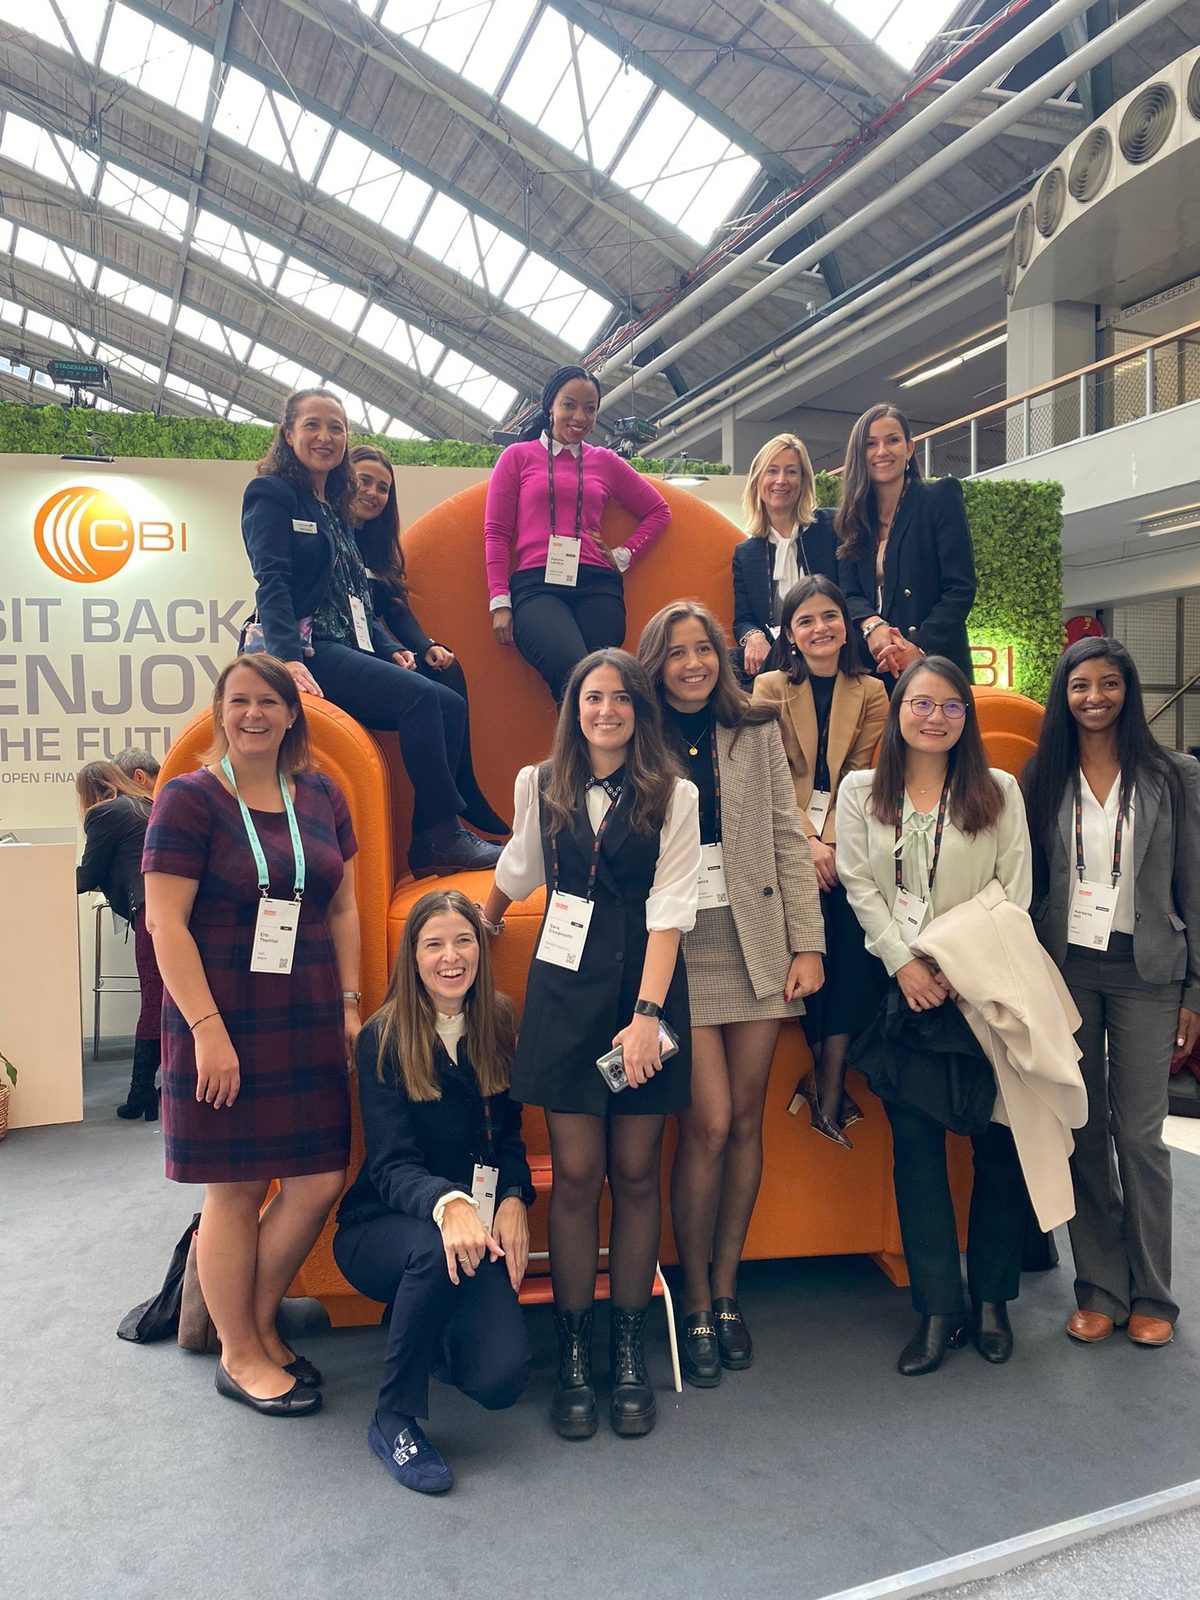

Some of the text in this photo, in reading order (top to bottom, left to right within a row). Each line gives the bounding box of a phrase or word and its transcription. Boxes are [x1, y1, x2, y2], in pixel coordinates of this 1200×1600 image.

[1125, 296, 1159, 318] COURSE
[1161, 280, 1195, 301] KEEPER
[90, 520, 186, 551] CBI
[0, 598, 247, 643] IT BACK
[2, 772, 80, 783] OPEN FINA
